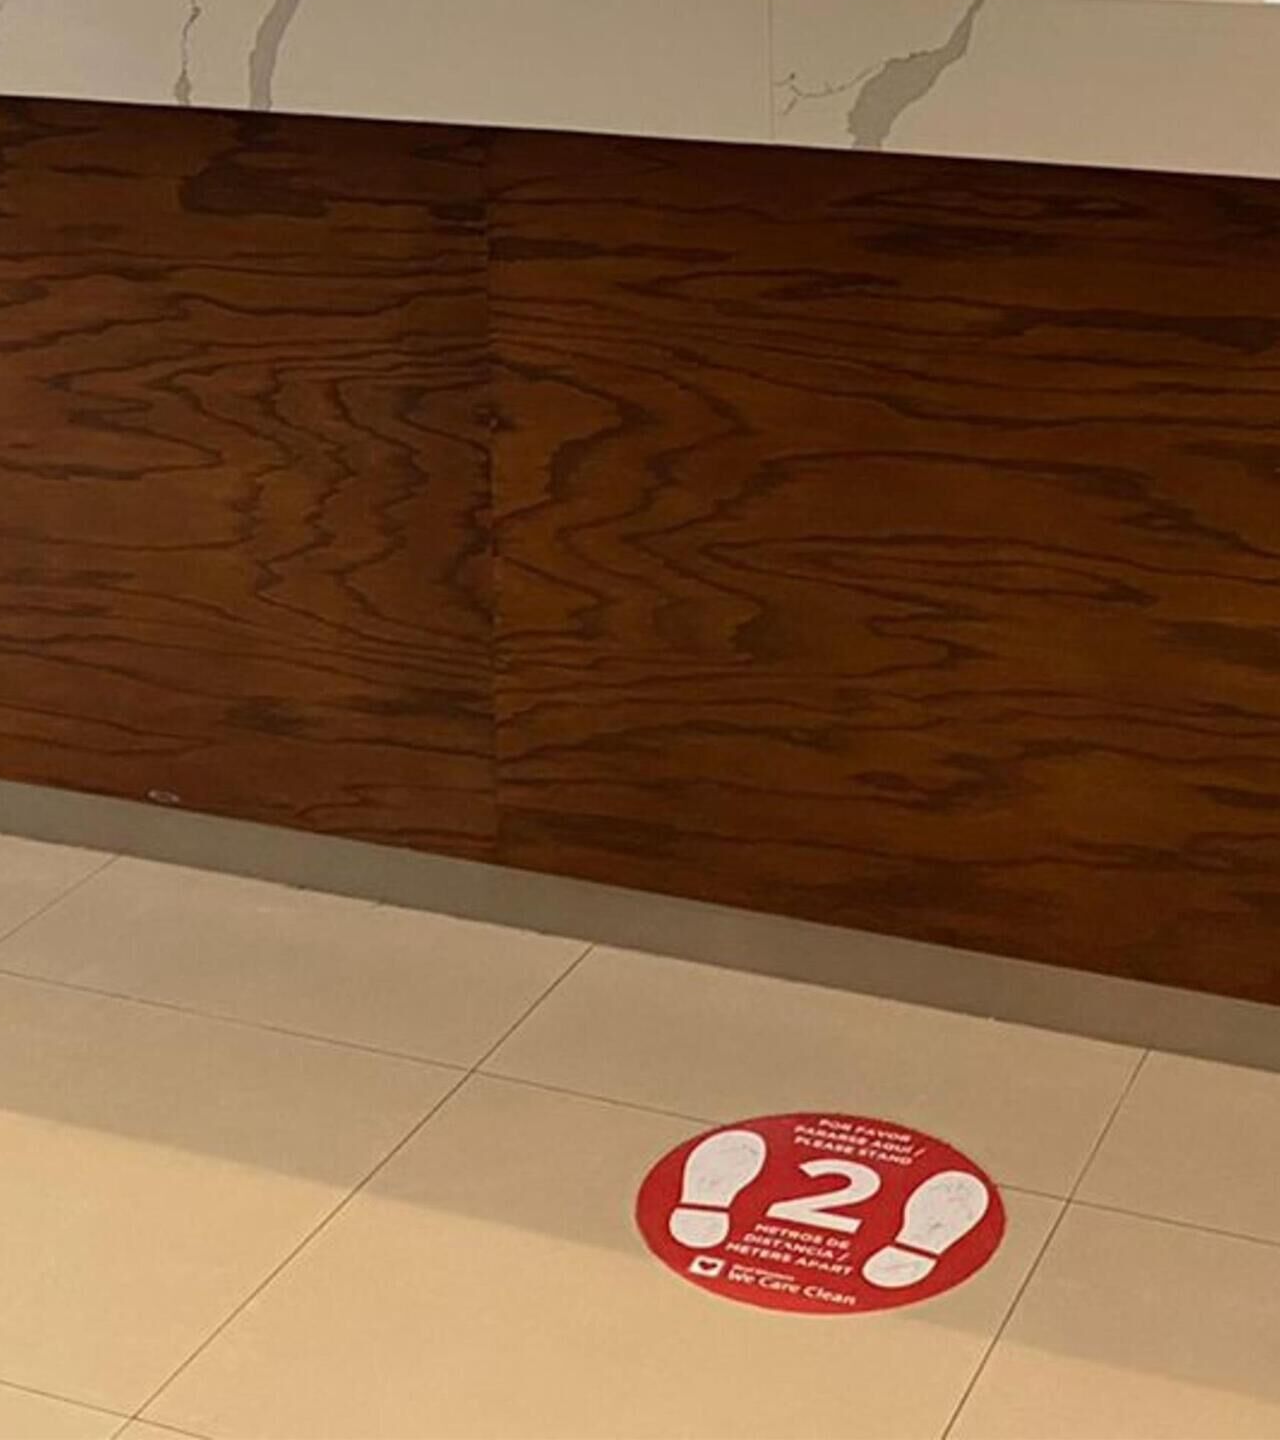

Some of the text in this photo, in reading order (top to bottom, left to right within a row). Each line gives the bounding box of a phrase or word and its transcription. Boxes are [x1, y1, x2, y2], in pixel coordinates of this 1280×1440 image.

[793, 1125, 869, 1146] PARARSE
[818, 1118, 912, 1142] POR FAVOR
[793, 1136, 913, 1165] PLEASE STAND
[765, 1159, 882, 1233] 2
[743, 1233, 835, 1260] DISTANCIA
[754, 1224, 850, 1249] METROS DE
[725, 1242, 793, 1262] METERS
[794, 1255, 854, 1275] APART
[728, 1270, 756, 1283] We
[758, 1275, 800, 1293] Care
[803, 1286, 857, 1305] Clean
